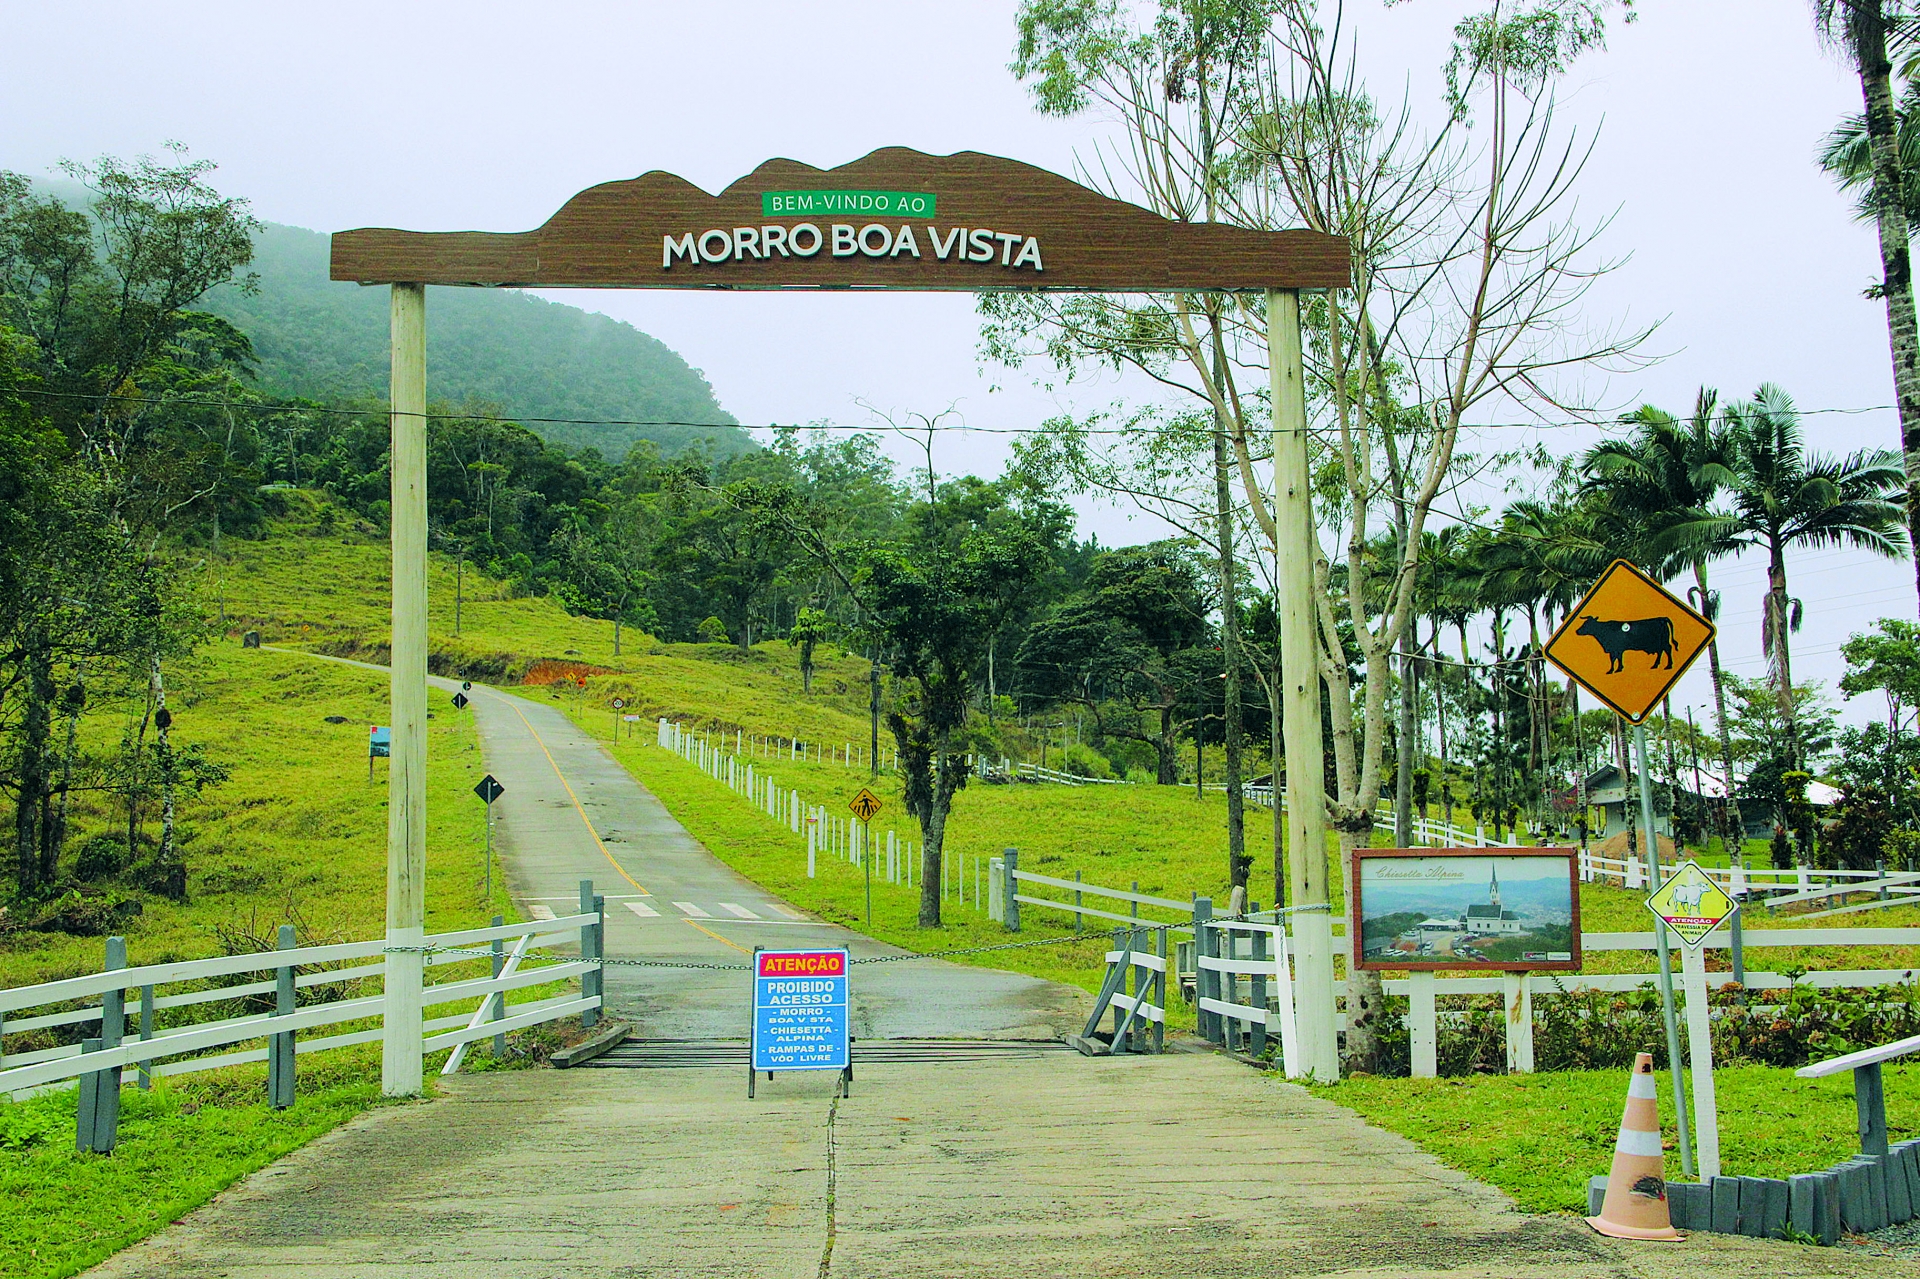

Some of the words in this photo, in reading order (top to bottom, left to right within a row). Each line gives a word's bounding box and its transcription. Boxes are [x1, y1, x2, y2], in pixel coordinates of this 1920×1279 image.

[771, 193, 889, 212] BEM-VINDO
[896, 196, 926, 213] AO
[662, 222, 823, 268] MORRO
[831, 223, 921, 259] BOA
[927, 225, 1043, 272] VISTA
[1376, 866, 1422, 878] Chiesetta
[1425, 866, 1464, 881] Alpina
[765, 955, 840, 974] ATENÇÃO
[767, 980, 835, 994] PROIBIDO
[769, 994, 833, 1005] ACESSO
[770, 1026, 832, 1034] CHIESETTA
[768, 1045, 815, 1054] RAMPAS
[818, 1044, 834, 1052] DE
[800, 1054, 832, 1062] LIVRE
